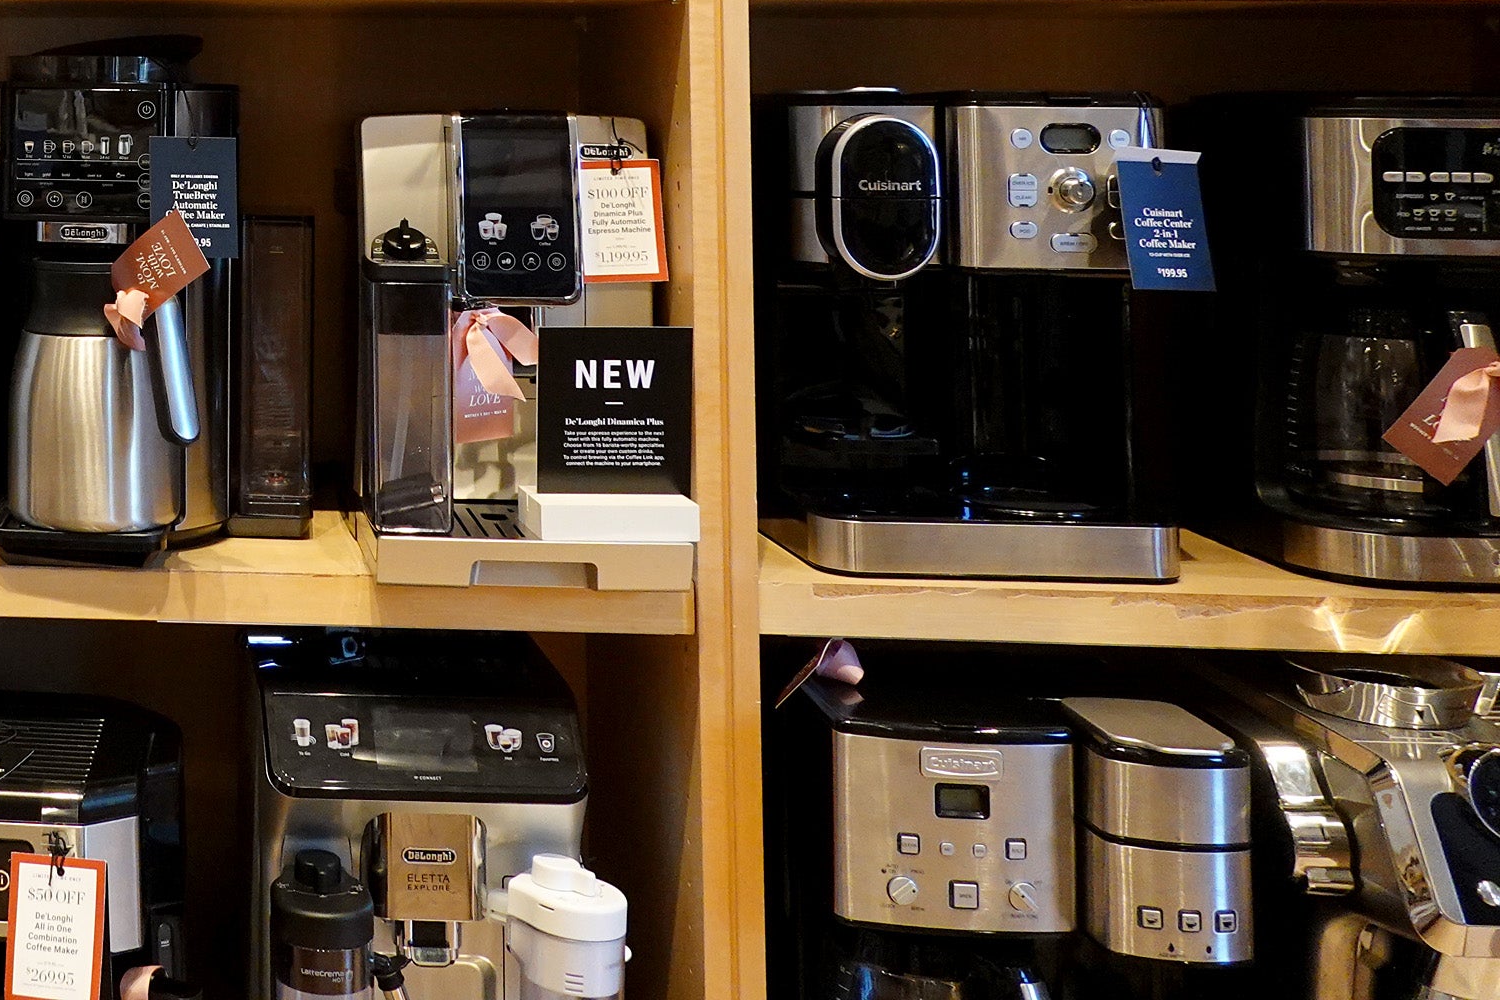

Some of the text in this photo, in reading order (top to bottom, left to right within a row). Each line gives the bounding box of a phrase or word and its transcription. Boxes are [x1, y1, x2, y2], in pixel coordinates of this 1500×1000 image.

[172, 181, 218, 191] De'Longhi
[858, 179, 922, 193] Cuisinart
[172, 191, 218, 200] TrueBrew
[587, 187, 649, 200] $100 OFF
[171, 200, 218, 210] Automatic
[196, 210, 226, 220] Maker
[593, 210, 626, 218] Dinamica
[1142, 207, 1183, 218] Cuisinart
[592, 218, 646, 227] Fully Automatic
[1134, 217, 1162, 228] Coffee
[1153, 229, 1179, 238] 2-in-1
[1139, 238, 1197, 250] Coffee Maker
[151, 242, 177, 277] LOVE
[595, 250, 649, 263] $1,199.95
[147, 253, 165, 278] with
[1157, 267, 1188, 278] $199.95
[575, 359, 655, 389] NEW
[565, 417, 664, 427] De'Longhi Dinamica Plus
[929, 756, 997, 771] Cuisinart
[407, 873, 450, 883] ELETTA
[27, 887, 86, 905] $50 OFF
[35, 912, 74, 923] De'Longhi
[34, 922, 72, 934] All in One
[28, 932, 77, 945] Combination
[26, 942, 78, 955] Coffee Maker
[26, 966, 74, 986] $269.95
